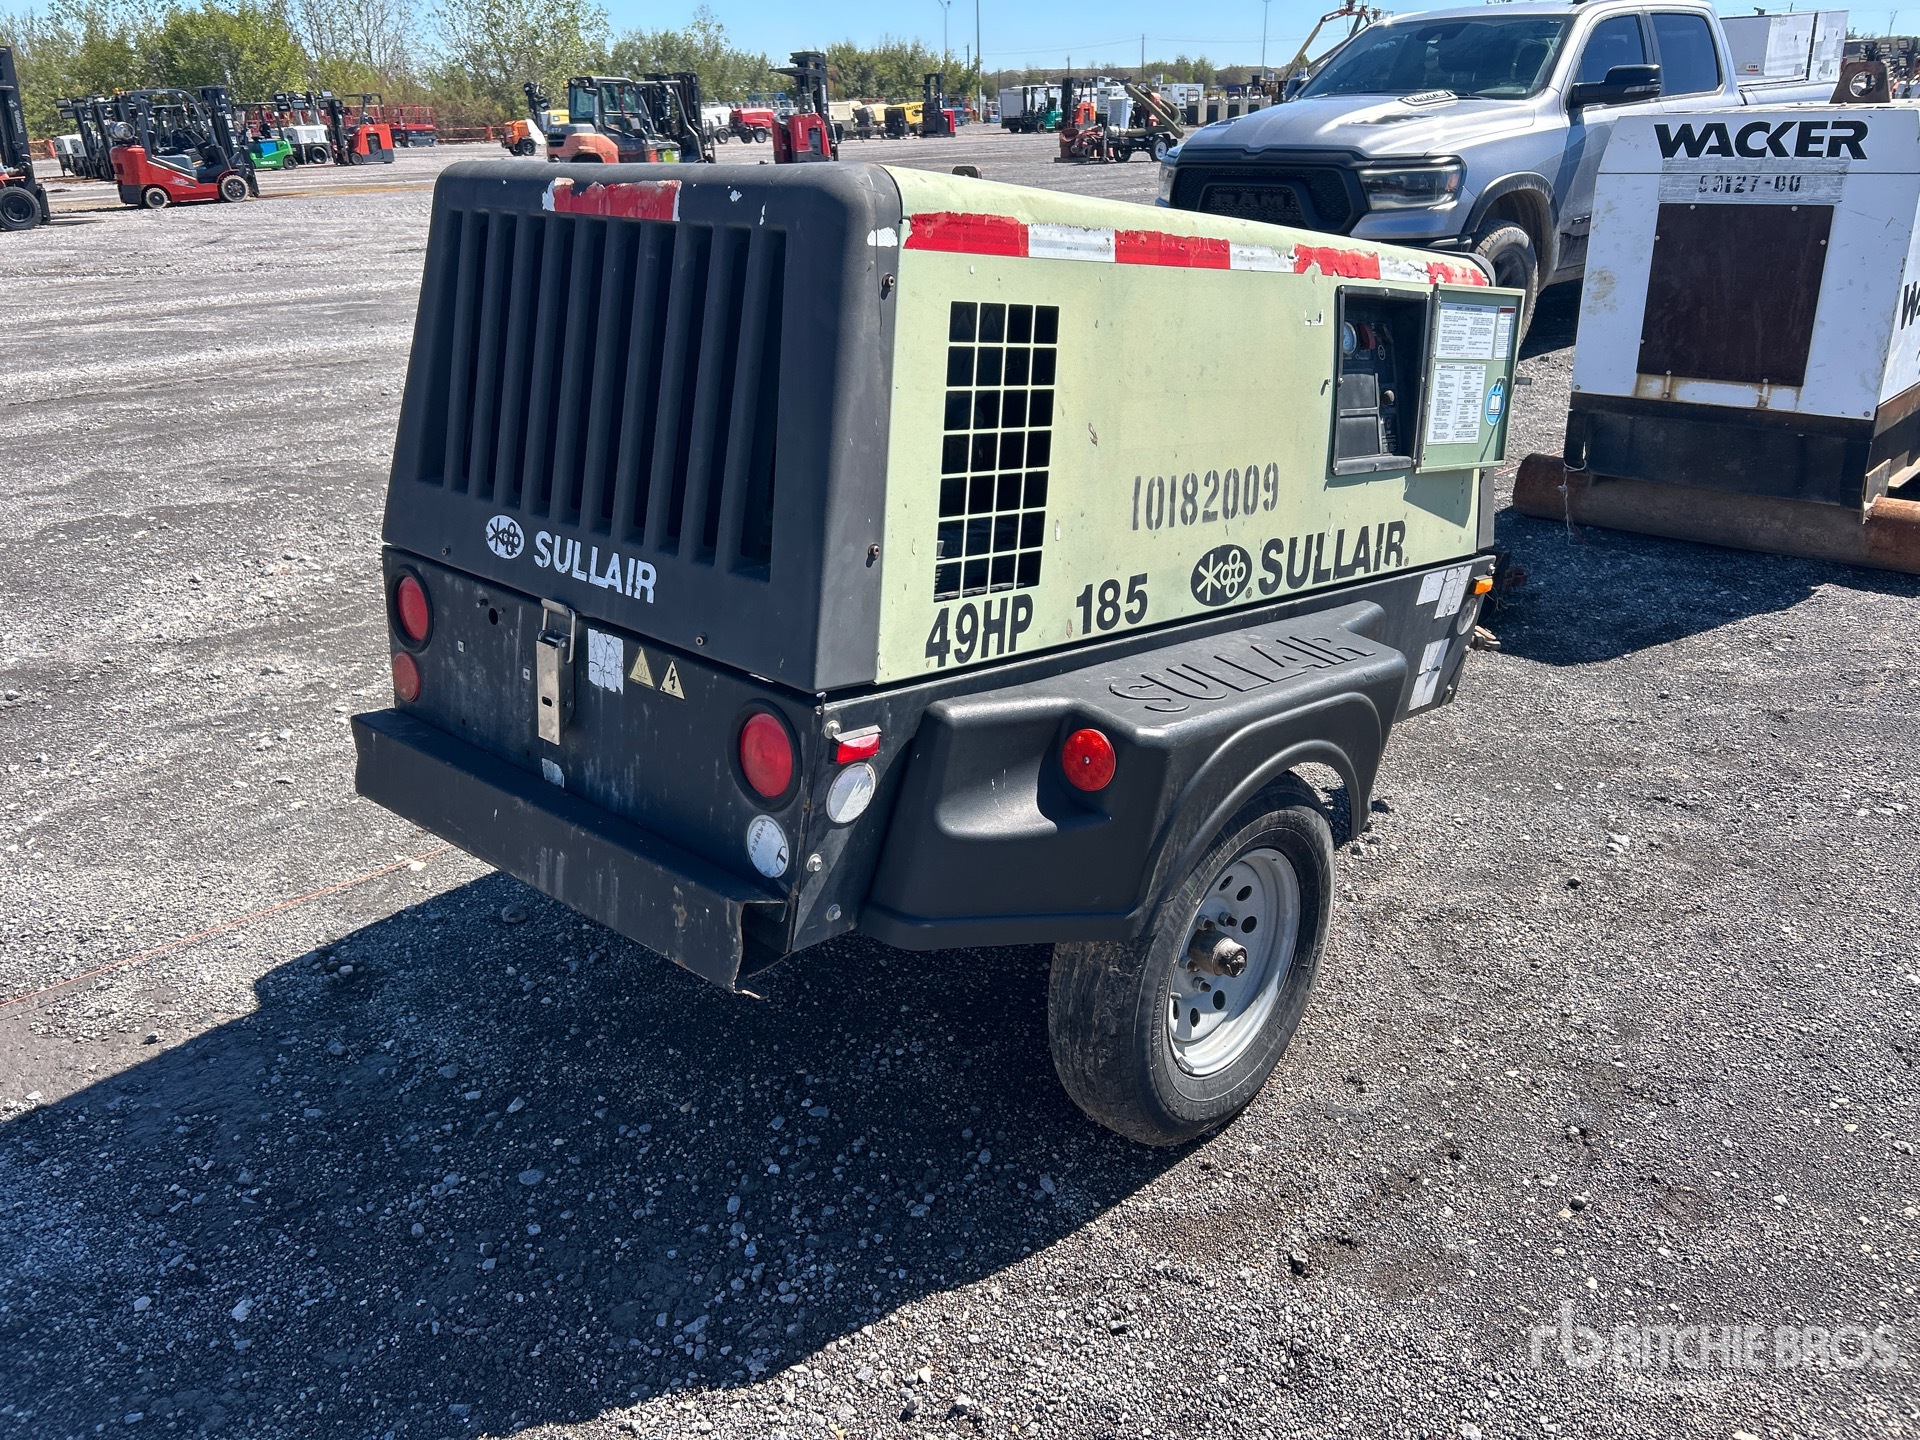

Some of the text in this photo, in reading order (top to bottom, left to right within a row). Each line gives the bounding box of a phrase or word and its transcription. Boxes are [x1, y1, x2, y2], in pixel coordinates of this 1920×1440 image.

[1653, 120, 1869, 160] WACKER
[1215, 193, 1285, 208] RAM
[1132, 462, 1279, 531] 10182009
[533, 530, 658, 604] SULLAIR
[1258, 520, 1407, 596] SULLAIR
[925, 593, 1034, 668] 49HP
[1076, 573, 1148, 635] 185
[1108, 636, 1376, 713] SULLAIR
